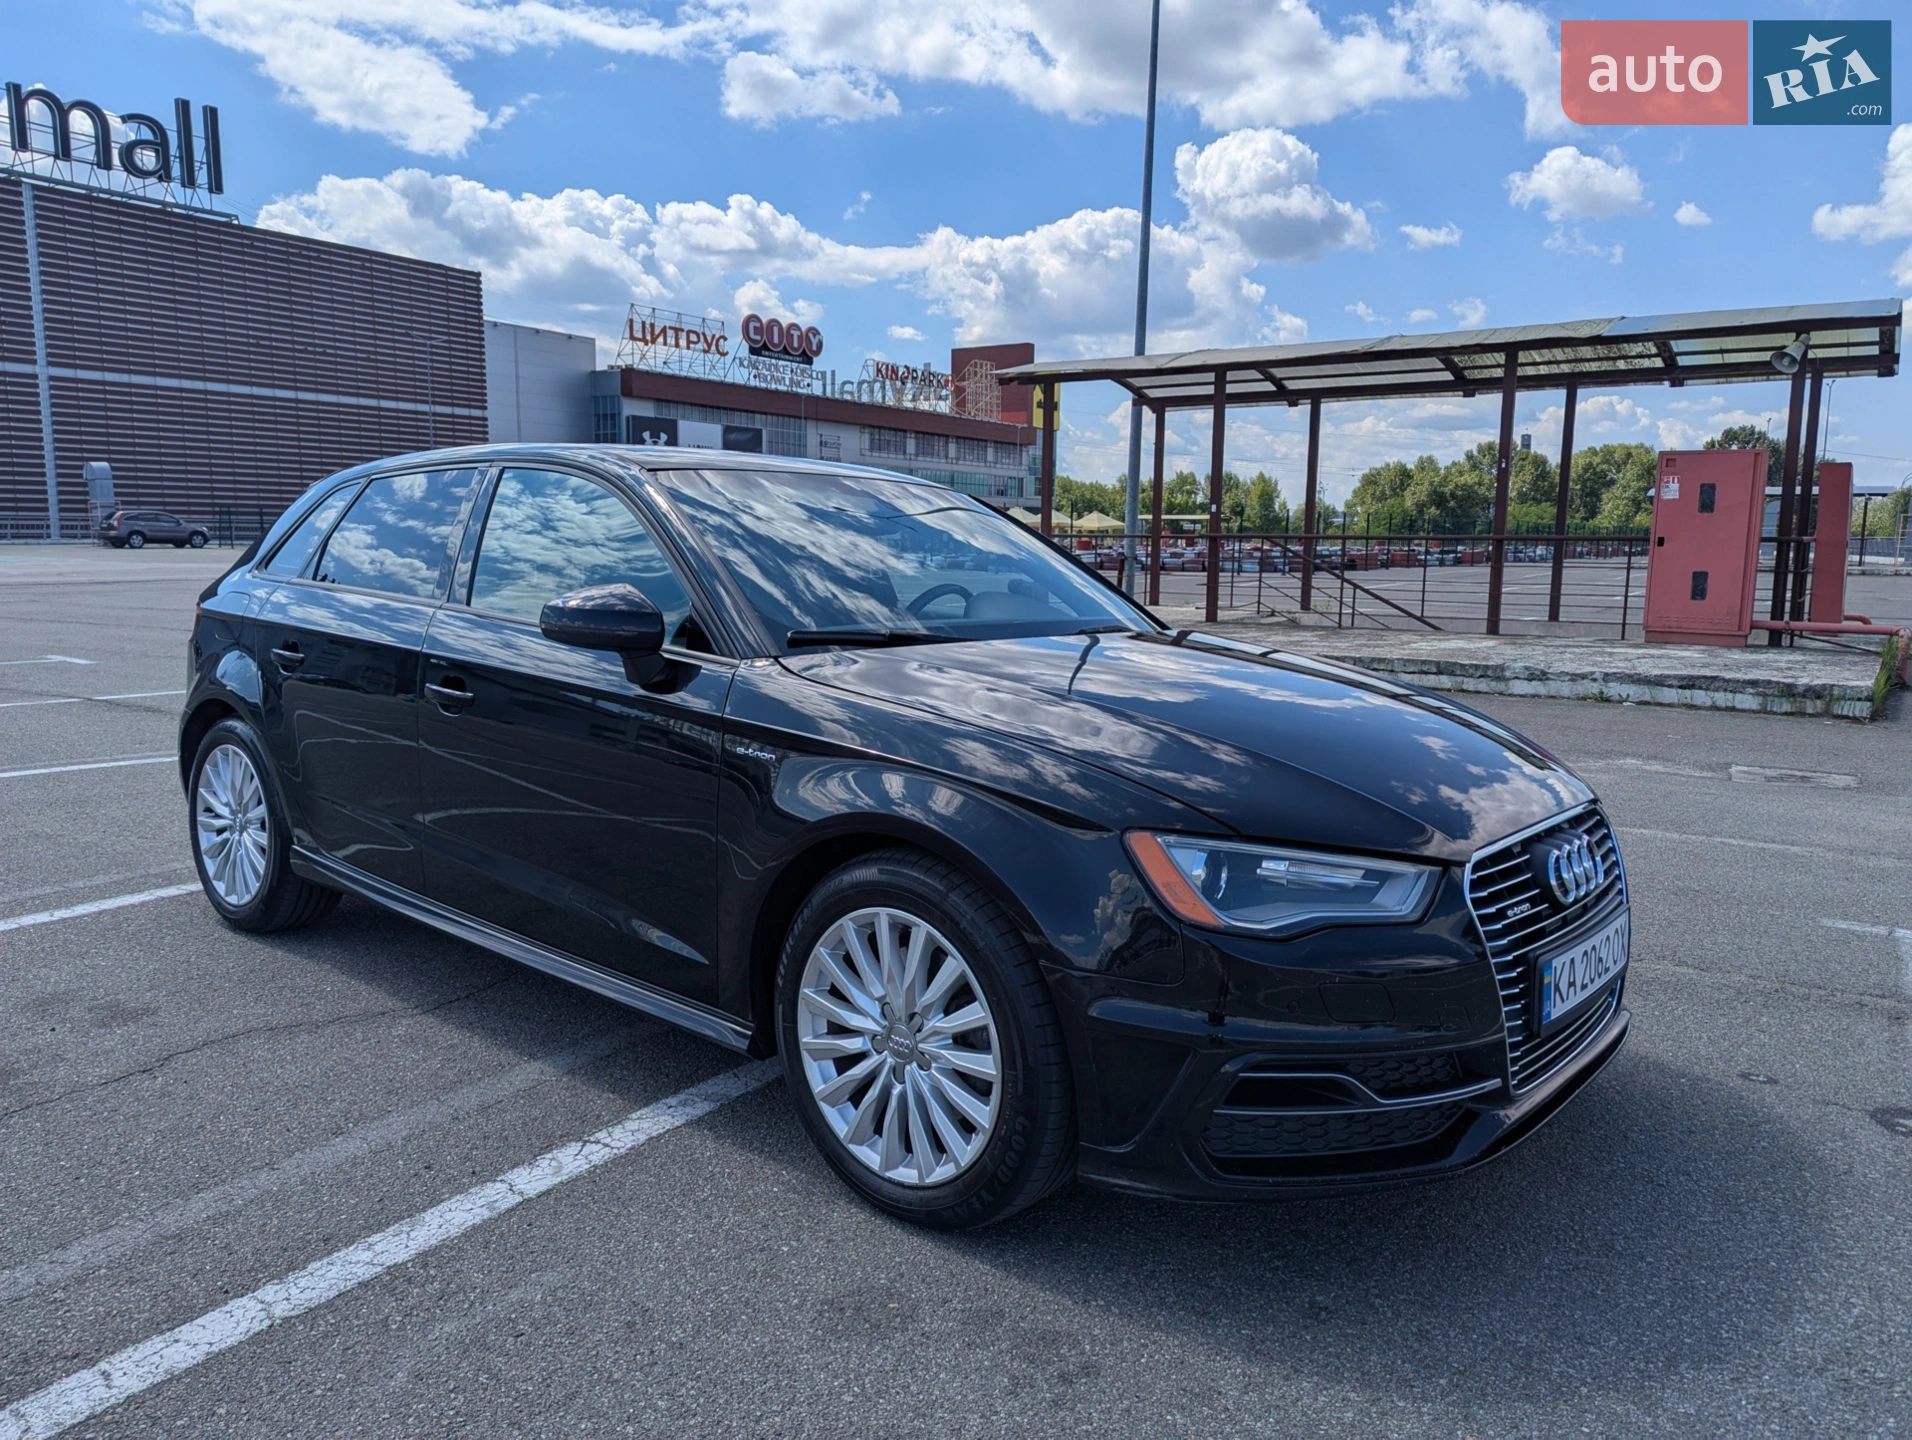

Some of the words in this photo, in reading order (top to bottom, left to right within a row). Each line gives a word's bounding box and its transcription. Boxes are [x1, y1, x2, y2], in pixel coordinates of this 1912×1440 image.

[5, 81, 224, 195] mall
[628, 318, 729, 357] ЦИТРУС
[747, 319, 821, 351] CITY
[739, 357, 790, 376] KARAOKE
[795, 365, 823, 380] DISCO
[757, 371, 806, 389] BOWLING
[736, 747, 776, 761] e-tron
[1507, 902, 1531, 917] e-tron
[1553, 956, 1577, 1010] KA
[1580, 935, 1610, 993] 2062
[1612, 919, 1627, 966] OX
